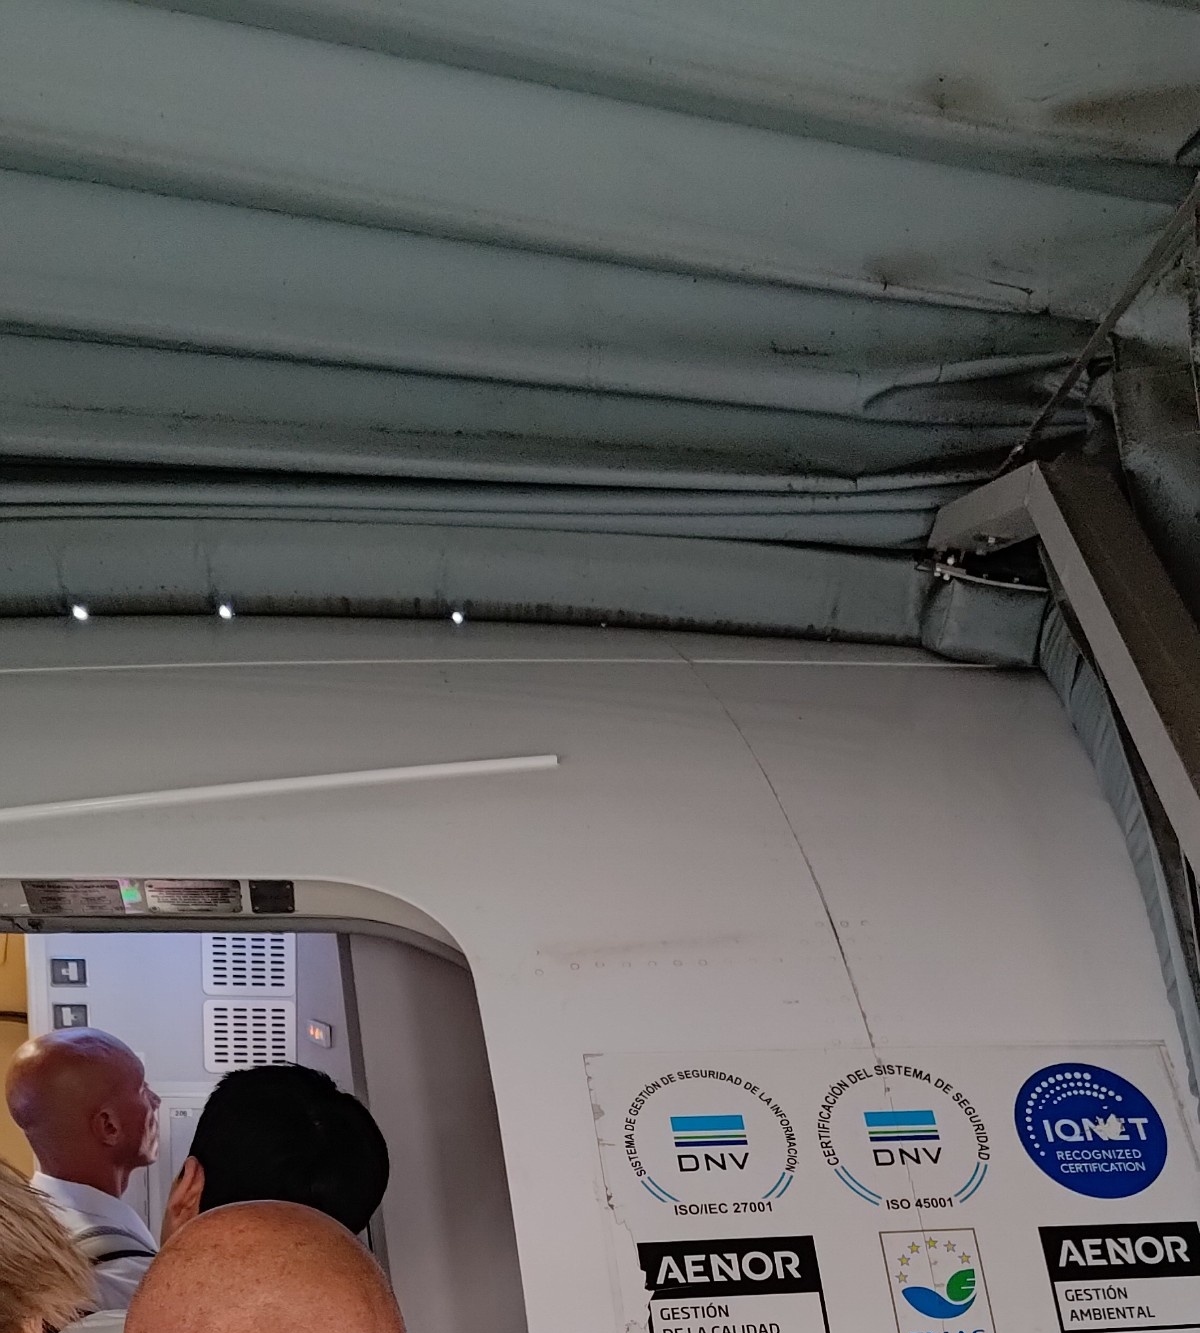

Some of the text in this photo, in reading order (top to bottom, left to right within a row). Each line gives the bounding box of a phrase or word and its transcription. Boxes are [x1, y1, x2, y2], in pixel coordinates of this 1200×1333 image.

[624, 1069, 800, 1177] SISTEMA DE GESTIÓN DE SEGURIDAD DE LA INFORMACIÓN
[817, 1064, 990, 1167] CERTIFICACIÓN DEL SISTEMA DE SEGURIDAD
[677, 1152, 749, 1172] DNV
[872, 1147, 942, 1166] DNV
[1056, 1149, 1142, 1161] RECOGNIZED
[1060, 1161, 1146, 1174] CERTIFICATION
[674, 1201, 773, 1216] ISO/IEC 27001
[886, 1197, 954, 1210] ISO 45001
[1058, 1235, 1191, 1267] AENOR
[656, 1251, 801, 1285] AENOR
[1064, 1285, 1128, 1302] GESTIÓN
[660, 1302, 730, 1321] GESTIÓN
[1069, 1305, 1156, 1322] AMBIENTAL
